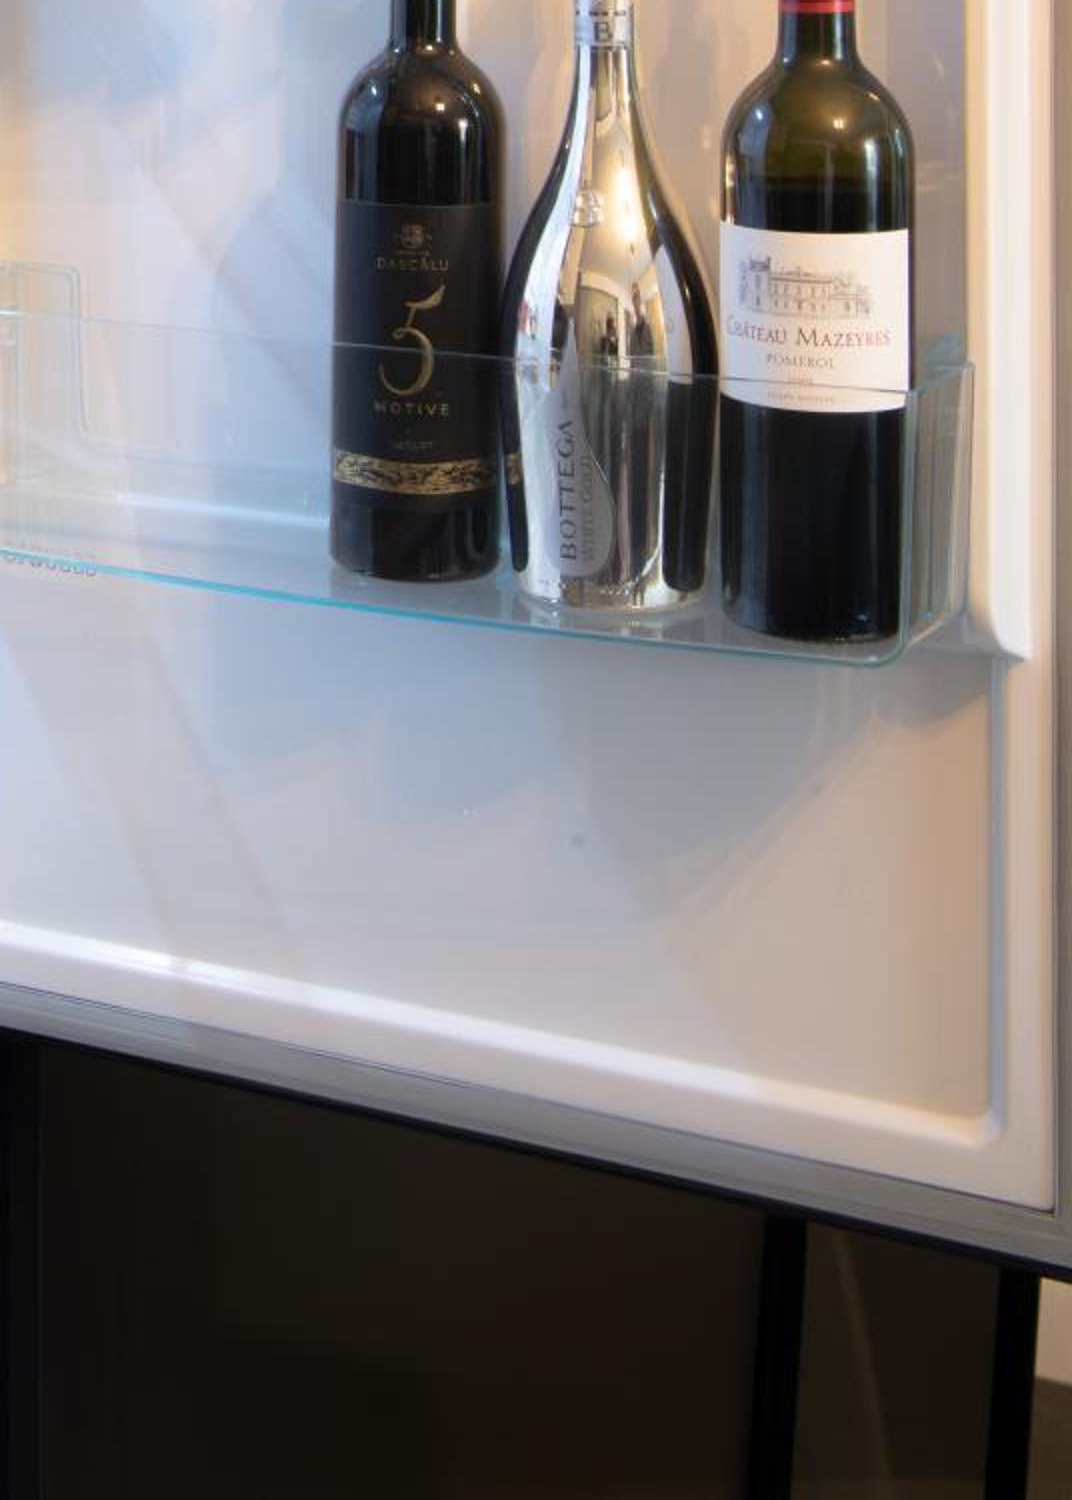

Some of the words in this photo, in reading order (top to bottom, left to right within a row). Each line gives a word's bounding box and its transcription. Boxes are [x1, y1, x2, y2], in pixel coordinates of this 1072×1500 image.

[379, 284, 446, 395] 5
[373, 401, 449, 416] MOTIVE
[558, 420, 577, 560] BOTTEGA
